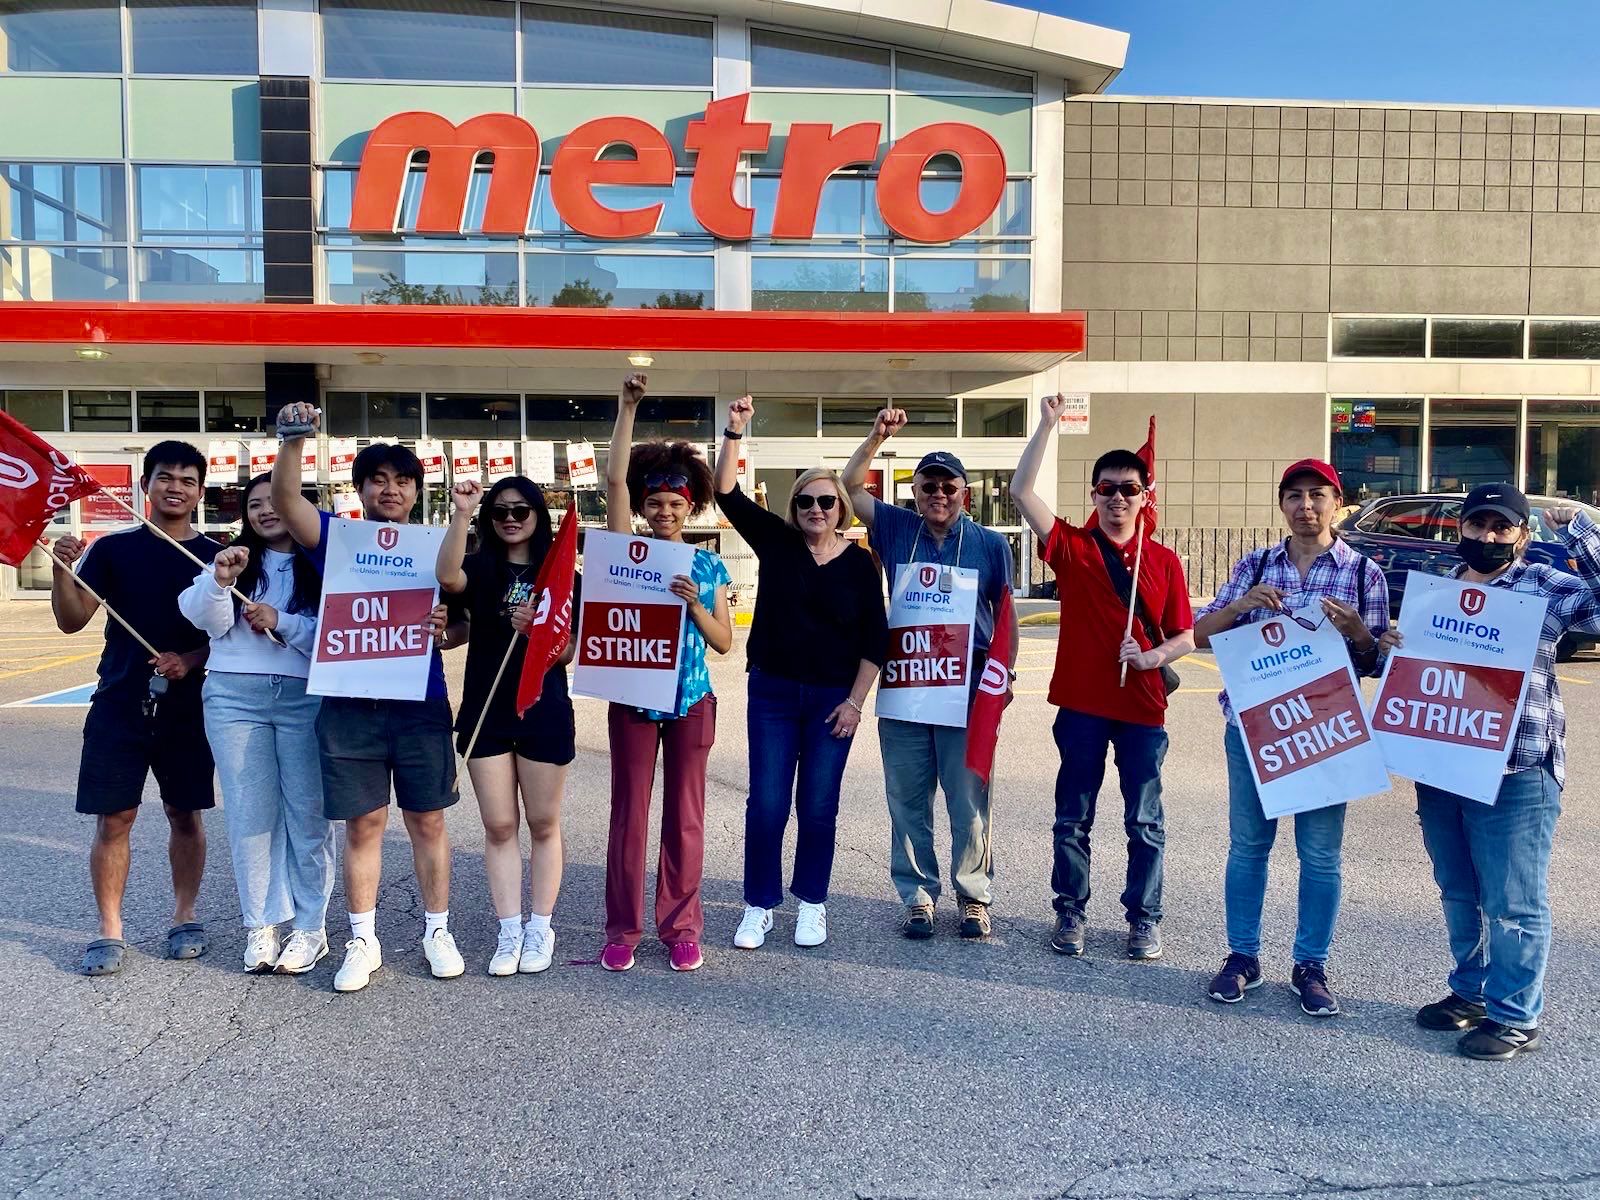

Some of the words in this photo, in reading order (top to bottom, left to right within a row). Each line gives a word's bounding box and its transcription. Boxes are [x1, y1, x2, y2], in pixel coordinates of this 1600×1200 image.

[349, 92, 1007, 242] metro
[424, 463, 443, 473] TRIKE
[352, 596, 389, 623] ON
[607, 607, 641, 633] ON
[326, 625, 422, 656] STRIKE
[586, 635, 672, 664] STRIKE
[901, 630, 931, 654] ON
[886, 658, 961, 682] STRIKE
[1419, 666, 1466, 700] ON
[1269, 693, 1314, 731] ON
[1383, 696, 1503, 742] STRIKE
[1258, 709, 1363, 773] STRIKE
